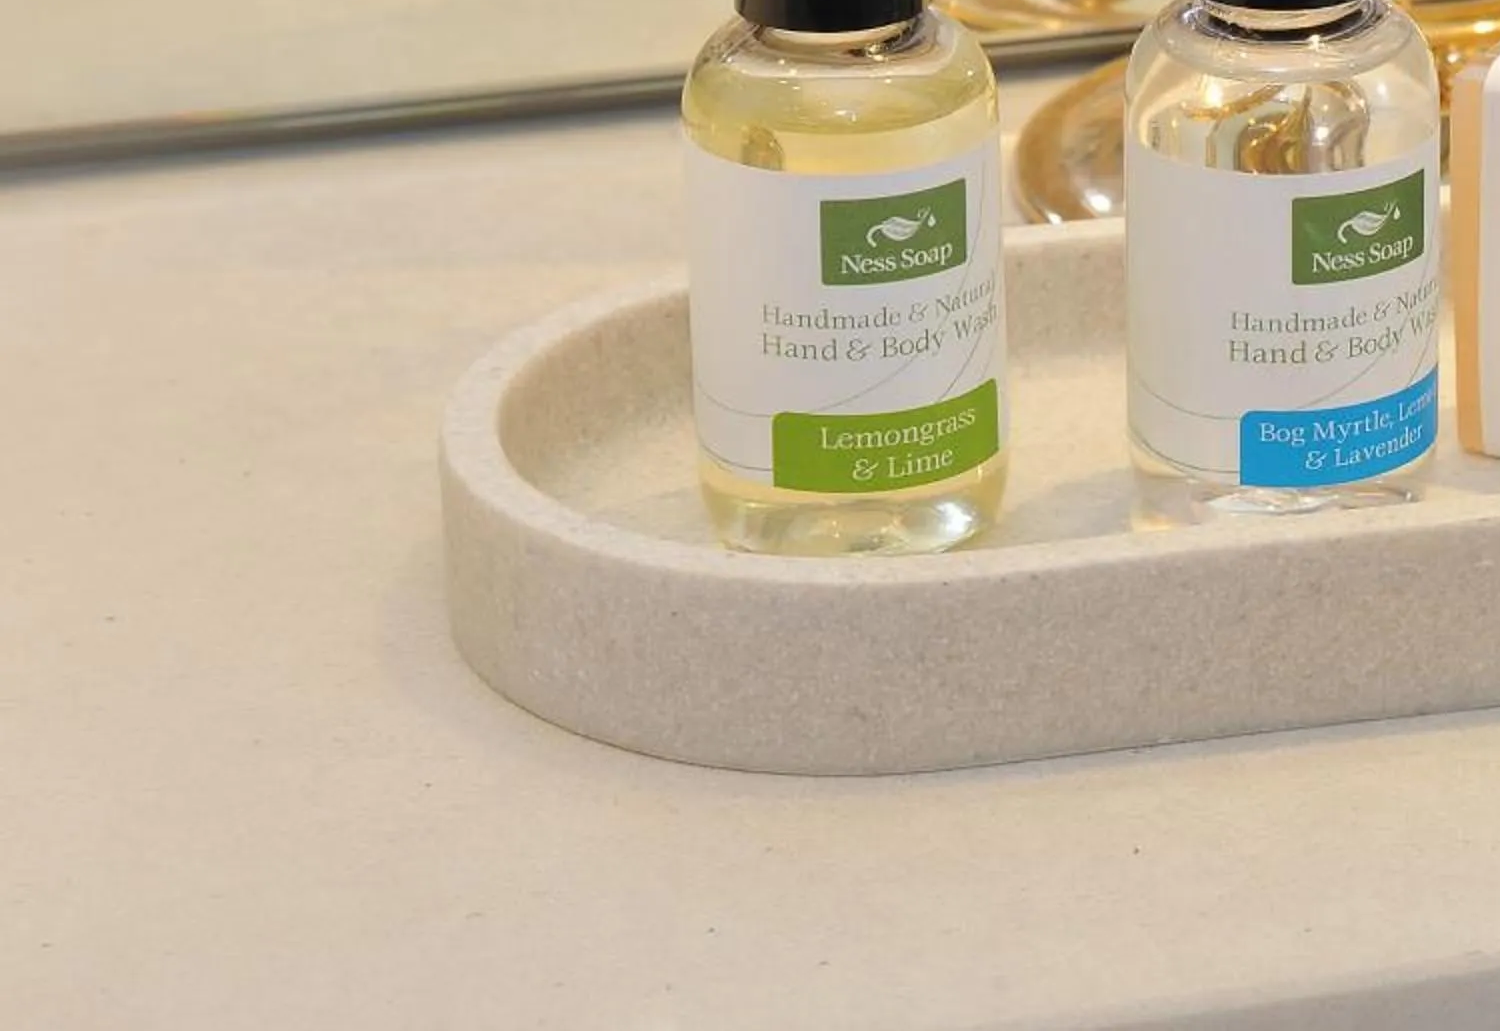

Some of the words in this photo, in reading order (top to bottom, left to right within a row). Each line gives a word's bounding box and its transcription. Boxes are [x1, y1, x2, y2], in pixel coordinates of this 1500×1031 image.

[841, 254, 896, 275] Ness
[901, 242, 953, 269] Soap
[1312, 251, 1365, 274] Ness
[1369, 234, 1414, 264] Soap
[762, 304, 902, 330] Handmade
[908, 301, 930, 324] &
[935, 278, 995, 319] Natura
[1230, 307, 1368, 334] Handmade
[1373, 300, 1393, 323] &
[761, 333, 838, 362] Hand
[846, 338, 873, 362] &
[881, 327, 946, 360] Body
[954, 304, 998, 340] Wash
[1228, 340, 1307, 365] Hand
[1314, 340, 1340, 362] &
[1347, 326, 1403, 360] Body
[820, 407, 976, 451] Lemongrass
[1260, 422, 1305, 447] Bog
[1313, 409, 1394, 444] Myrtle,
[1305, 450, 1328, 471] &
[1334, 424, 1423, 468] Lavender
[852, 458, 880, 482] &
[887, 447, 954, 479] Lime
